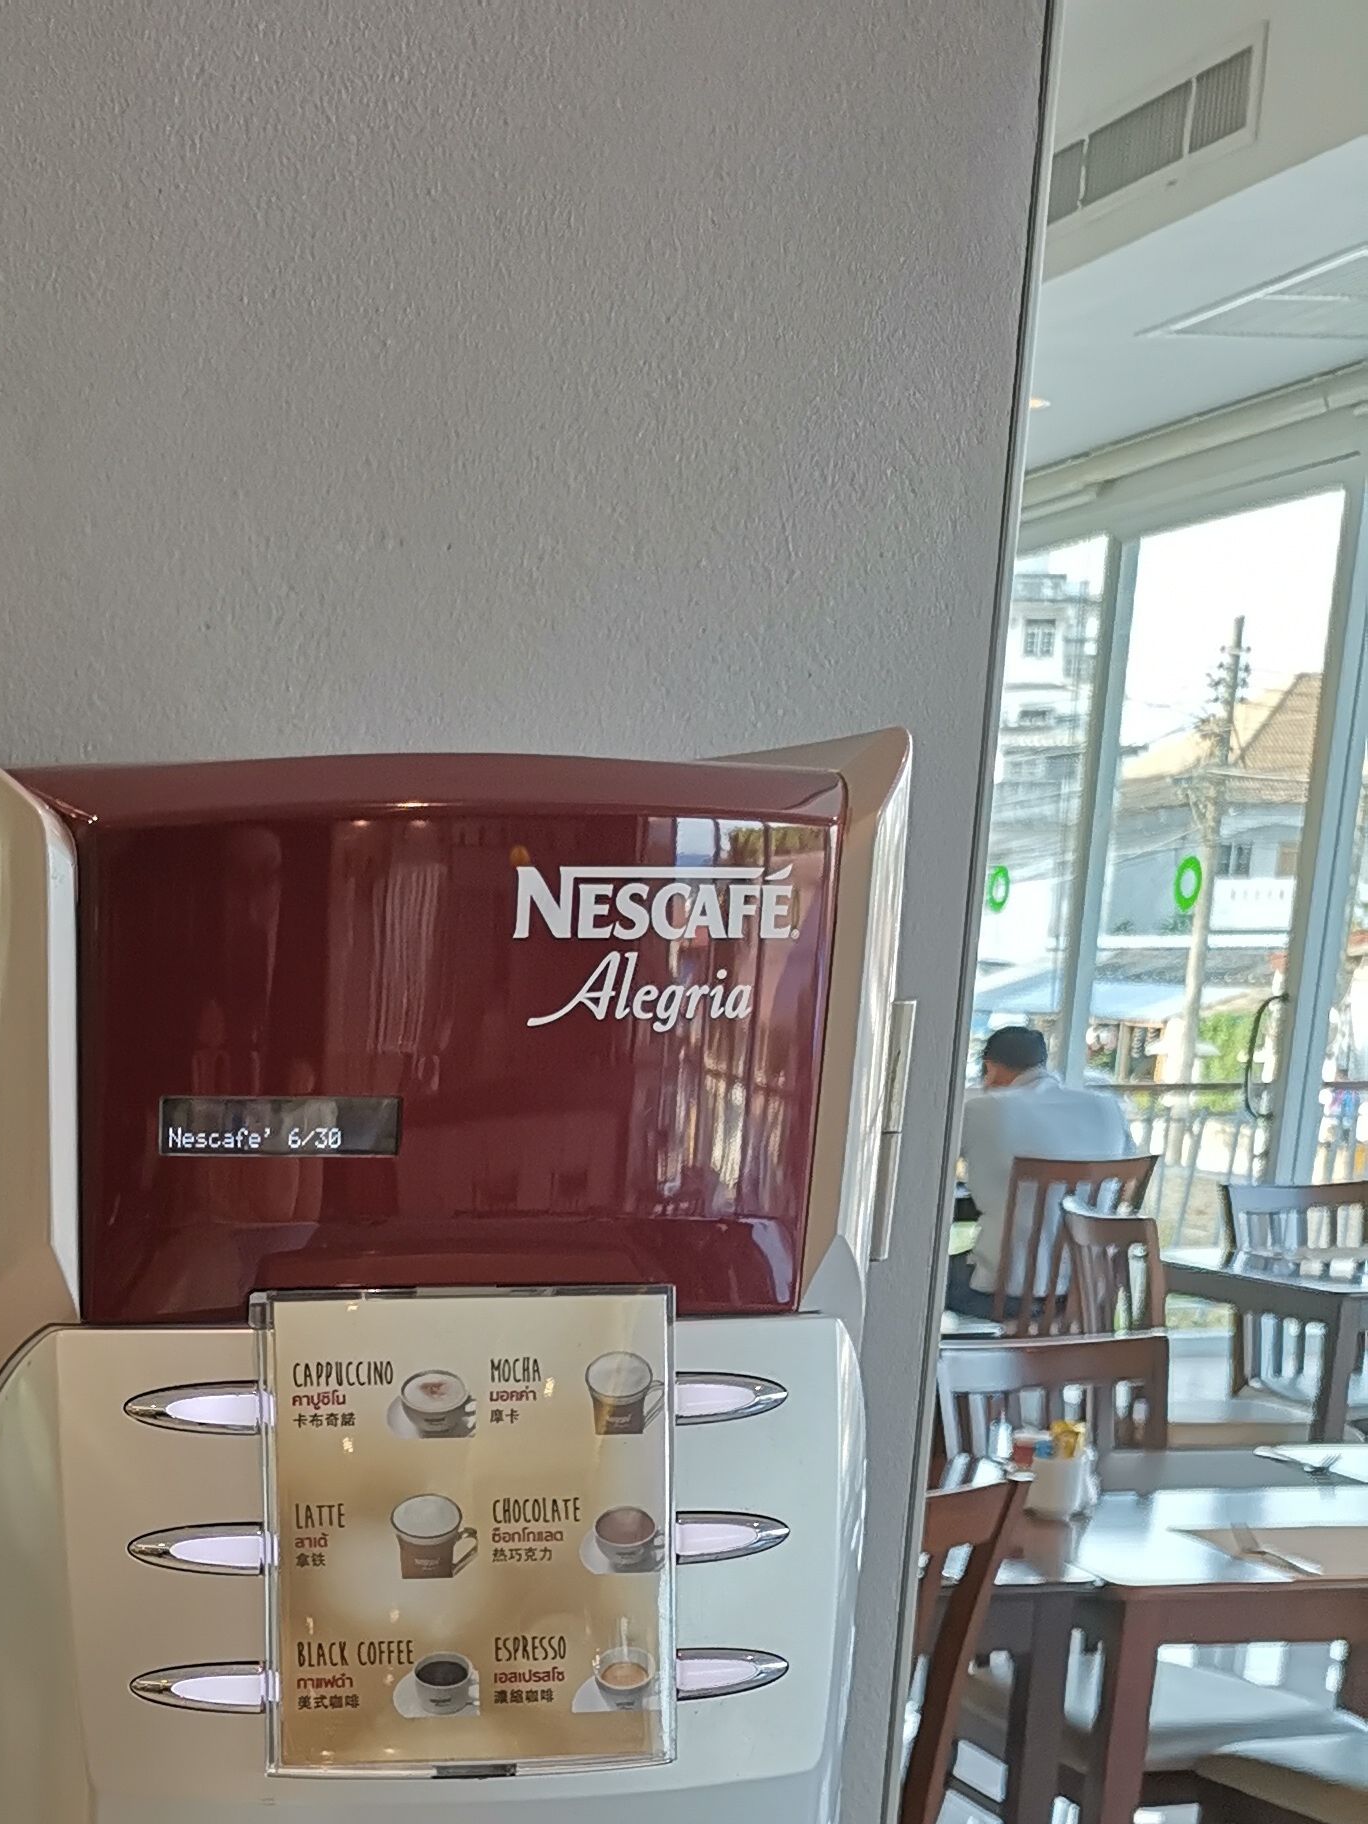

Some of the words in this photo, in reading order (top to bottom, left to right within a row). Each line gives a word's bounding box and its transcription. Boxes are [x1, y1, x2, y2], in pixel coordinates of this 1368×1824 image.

[526, 951, 753, 1033] Alegria
[287, 1127, 342, 1149] 6/30
[292, 1360, 394, 1388] CAPPUCCINO
[489, 1356, 542, 1384] MOCHA
[489, 1408, 520, 1425] 摩卡
[295, 1502, 346, 1530] LATTE
[492, 1496, 582, 1524] CHOCOLATE
[296, 1640, 349, 1668] BLACK
[357, 1639, 415, 1667] COFFEE
[493, 1634, 567, 1663] ESPRESSO
